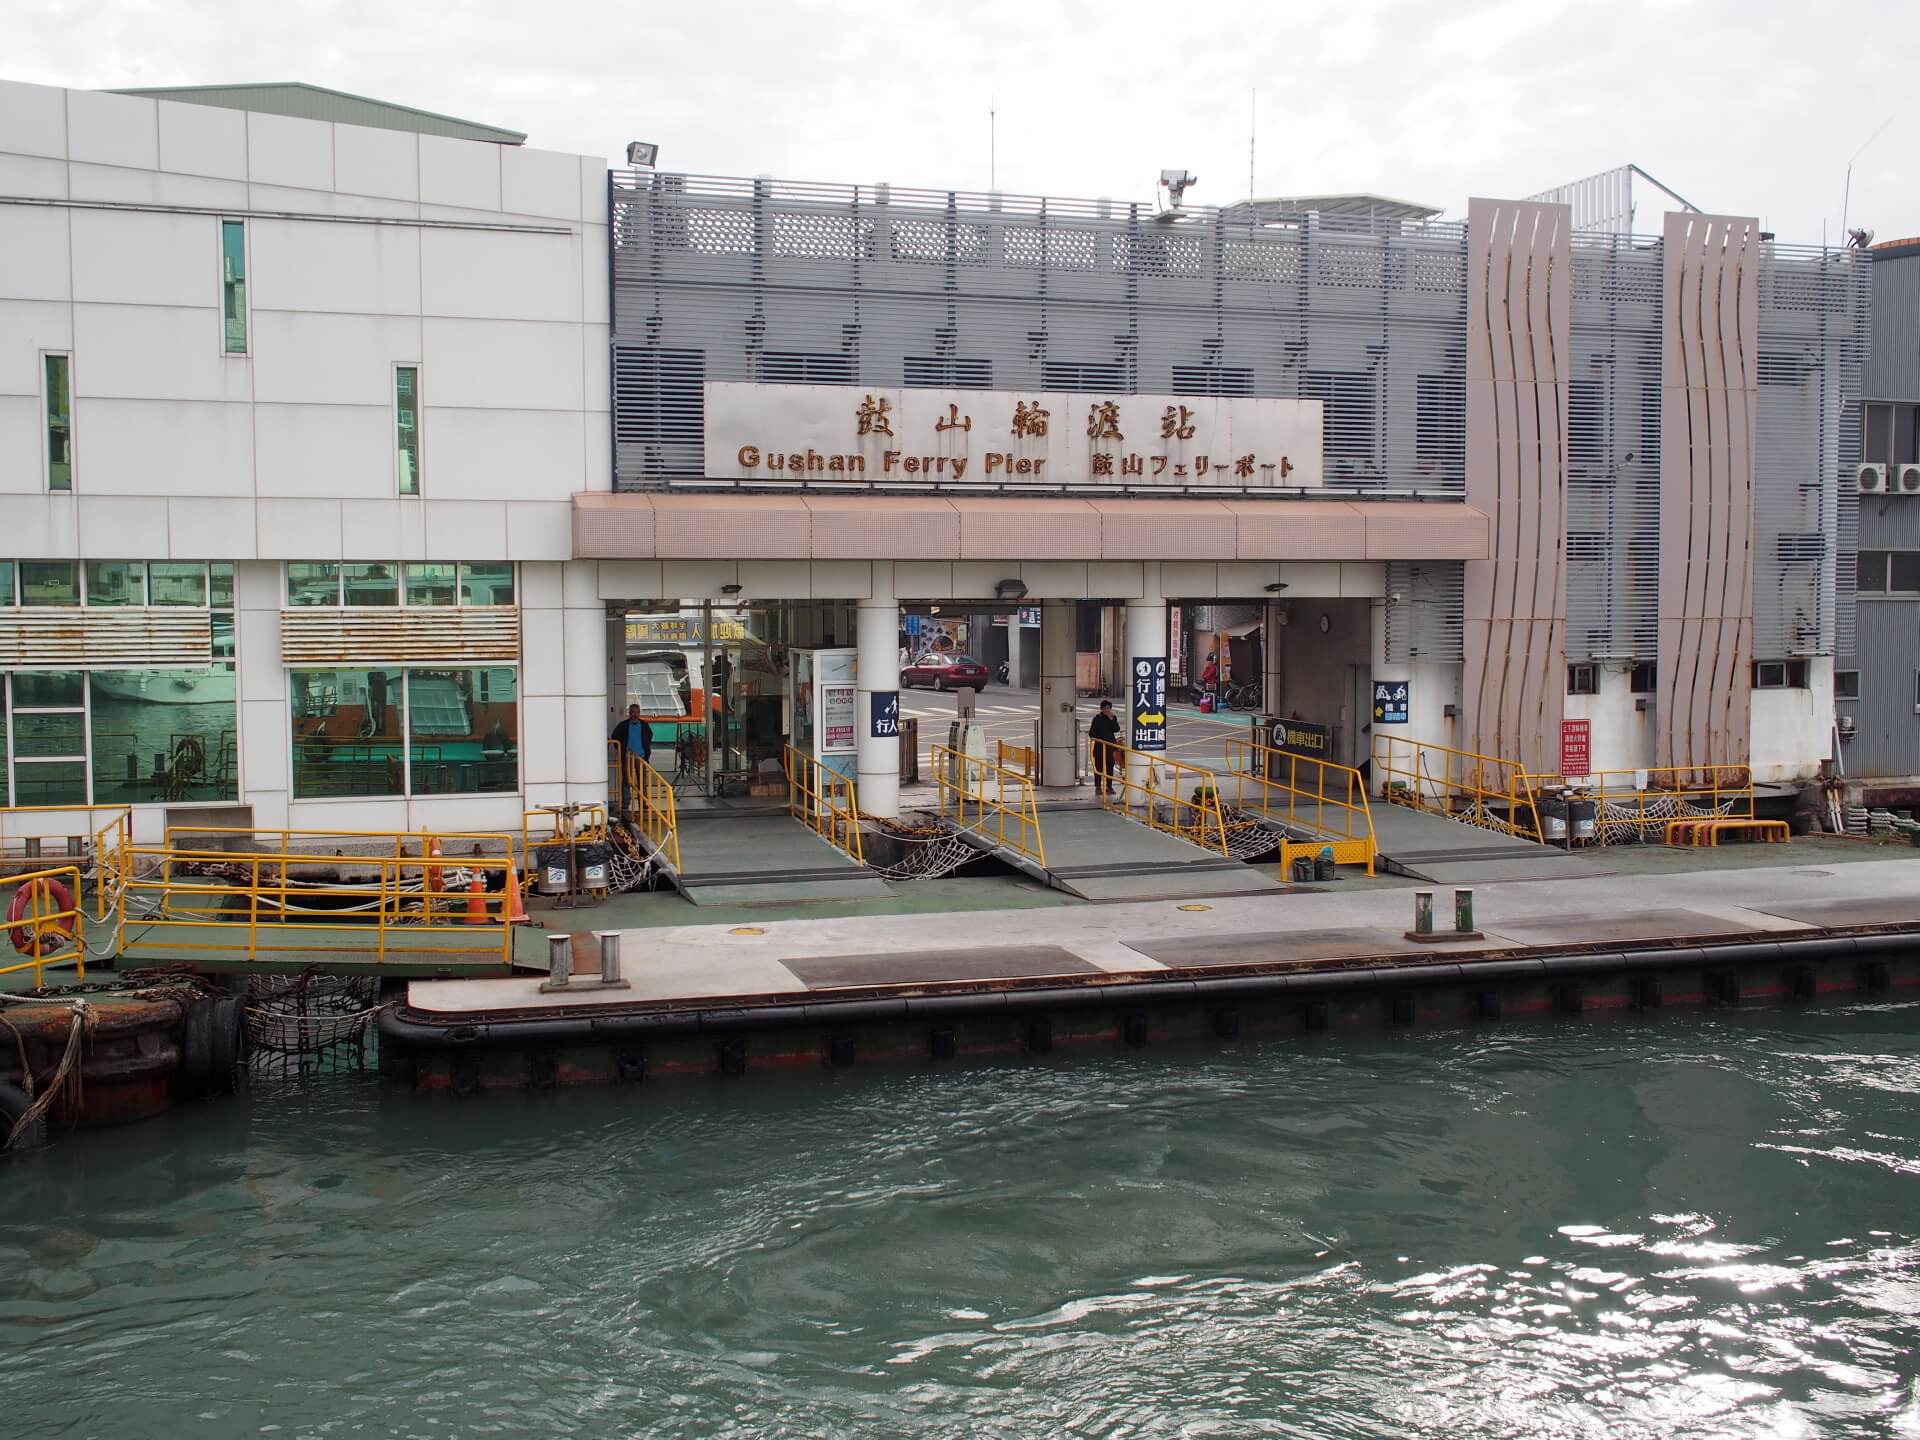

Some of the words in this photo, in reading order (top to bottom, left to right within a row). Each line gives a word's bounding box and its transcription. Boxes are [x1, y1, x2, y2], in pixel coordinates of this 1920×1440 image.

[738, 445, 865, 472] Gushan
[883, 450, 968, 479] Ferry
[985, 452, 1046, 474] Pier
[1136, 678, 1151, 708] 行人
[876, 719, 898, 734] 行人
[1287, 728, 1324, 749] 機車出口
